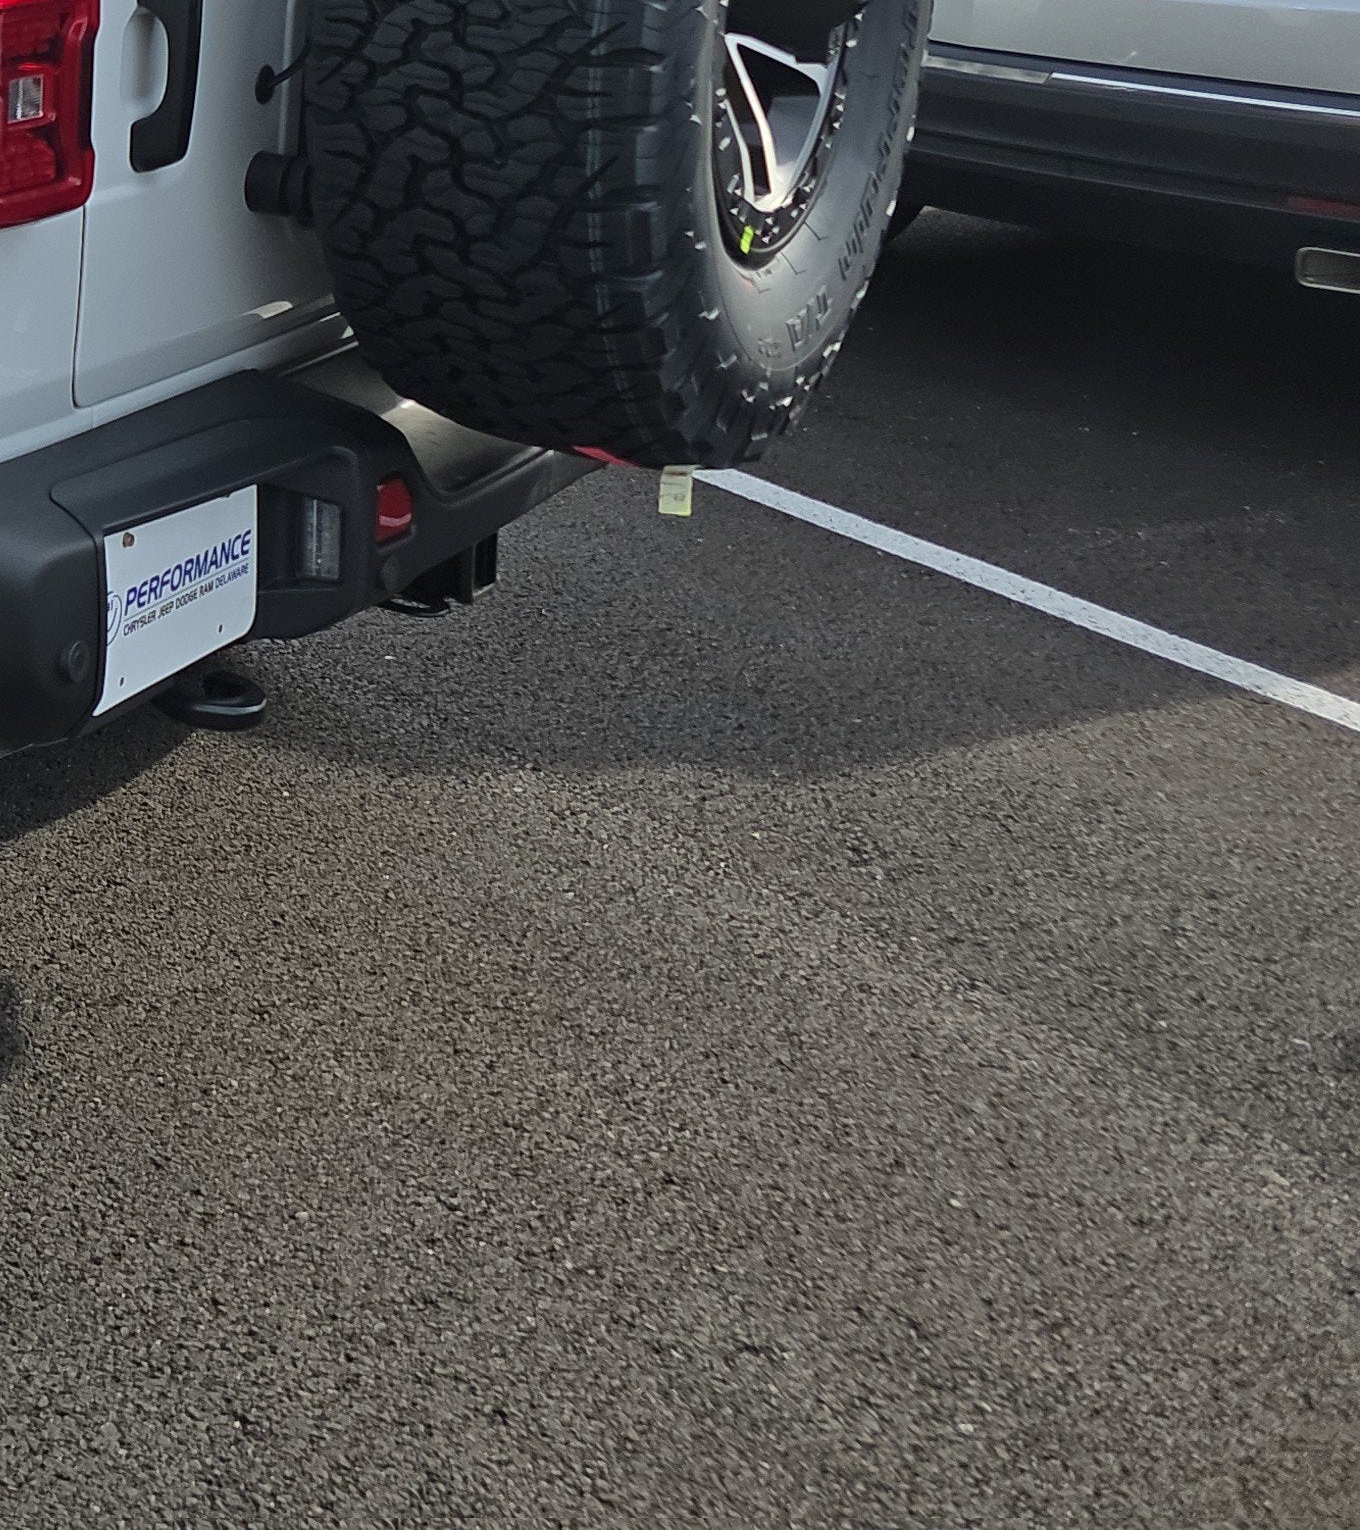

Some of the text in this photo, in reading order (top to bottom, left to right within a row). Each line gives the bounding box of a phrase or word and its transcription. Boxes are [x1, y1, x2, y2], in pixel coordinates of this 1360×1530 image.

[123, 562, 249, 636] CHRYSLER JEEP DODGE RAM DELAWARE
[124, 529, 252, 616] PERFORMANCE
